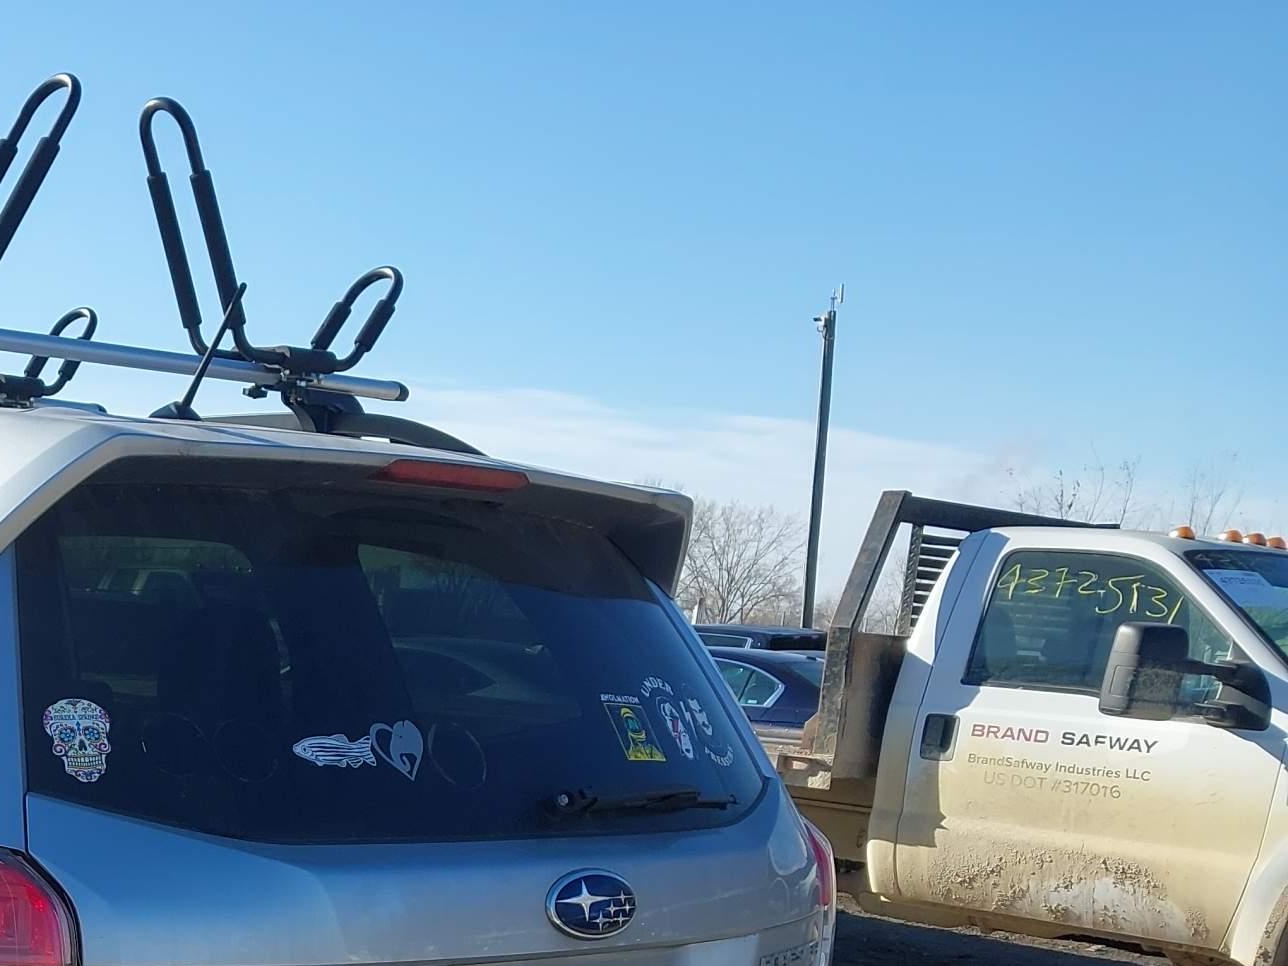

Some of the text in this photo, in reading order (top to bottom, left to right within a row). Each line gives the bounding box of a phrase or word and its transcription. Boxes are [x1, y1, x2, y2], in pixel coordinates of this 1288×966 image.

[997, 564, 1184, 625] 43725131
[641, 676, 674, 697] UNDER
[971, 724, 1158, 753] BRAND SAFWAY
[968, 753, 1151, 782] BrandSafway Industries LLC
[984, 771, 1121, 799] US DOT #317016
